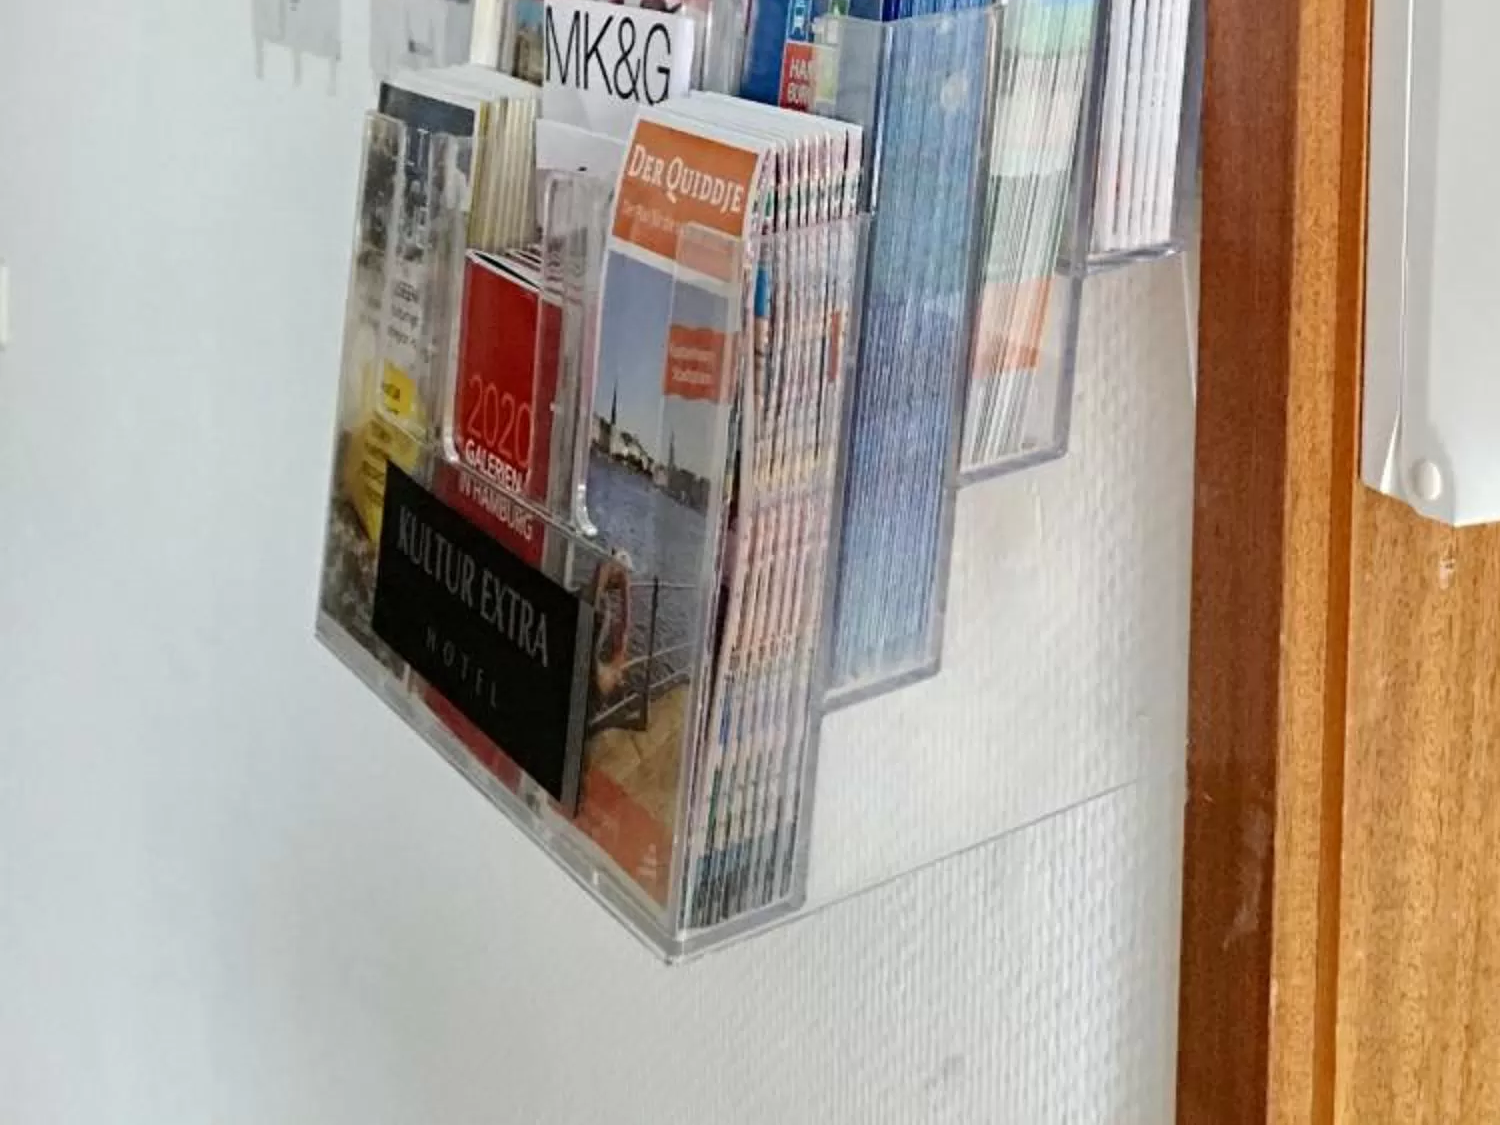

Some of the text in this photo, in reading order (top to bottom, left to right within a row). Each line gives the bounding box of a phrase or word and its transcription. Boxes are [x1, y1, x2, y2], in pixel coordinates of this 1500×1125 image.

[546, 6, 671, 106] MK&G
[628, 144, 745, 214] DER QUIDDJE
[466, 374, 533, 467] 2020
[465, 439, 523, 493] GALERIEN
[473, 480, 533, 542] HAMBURG
[398, 505, 549, 668] KULTUR EXTRA
